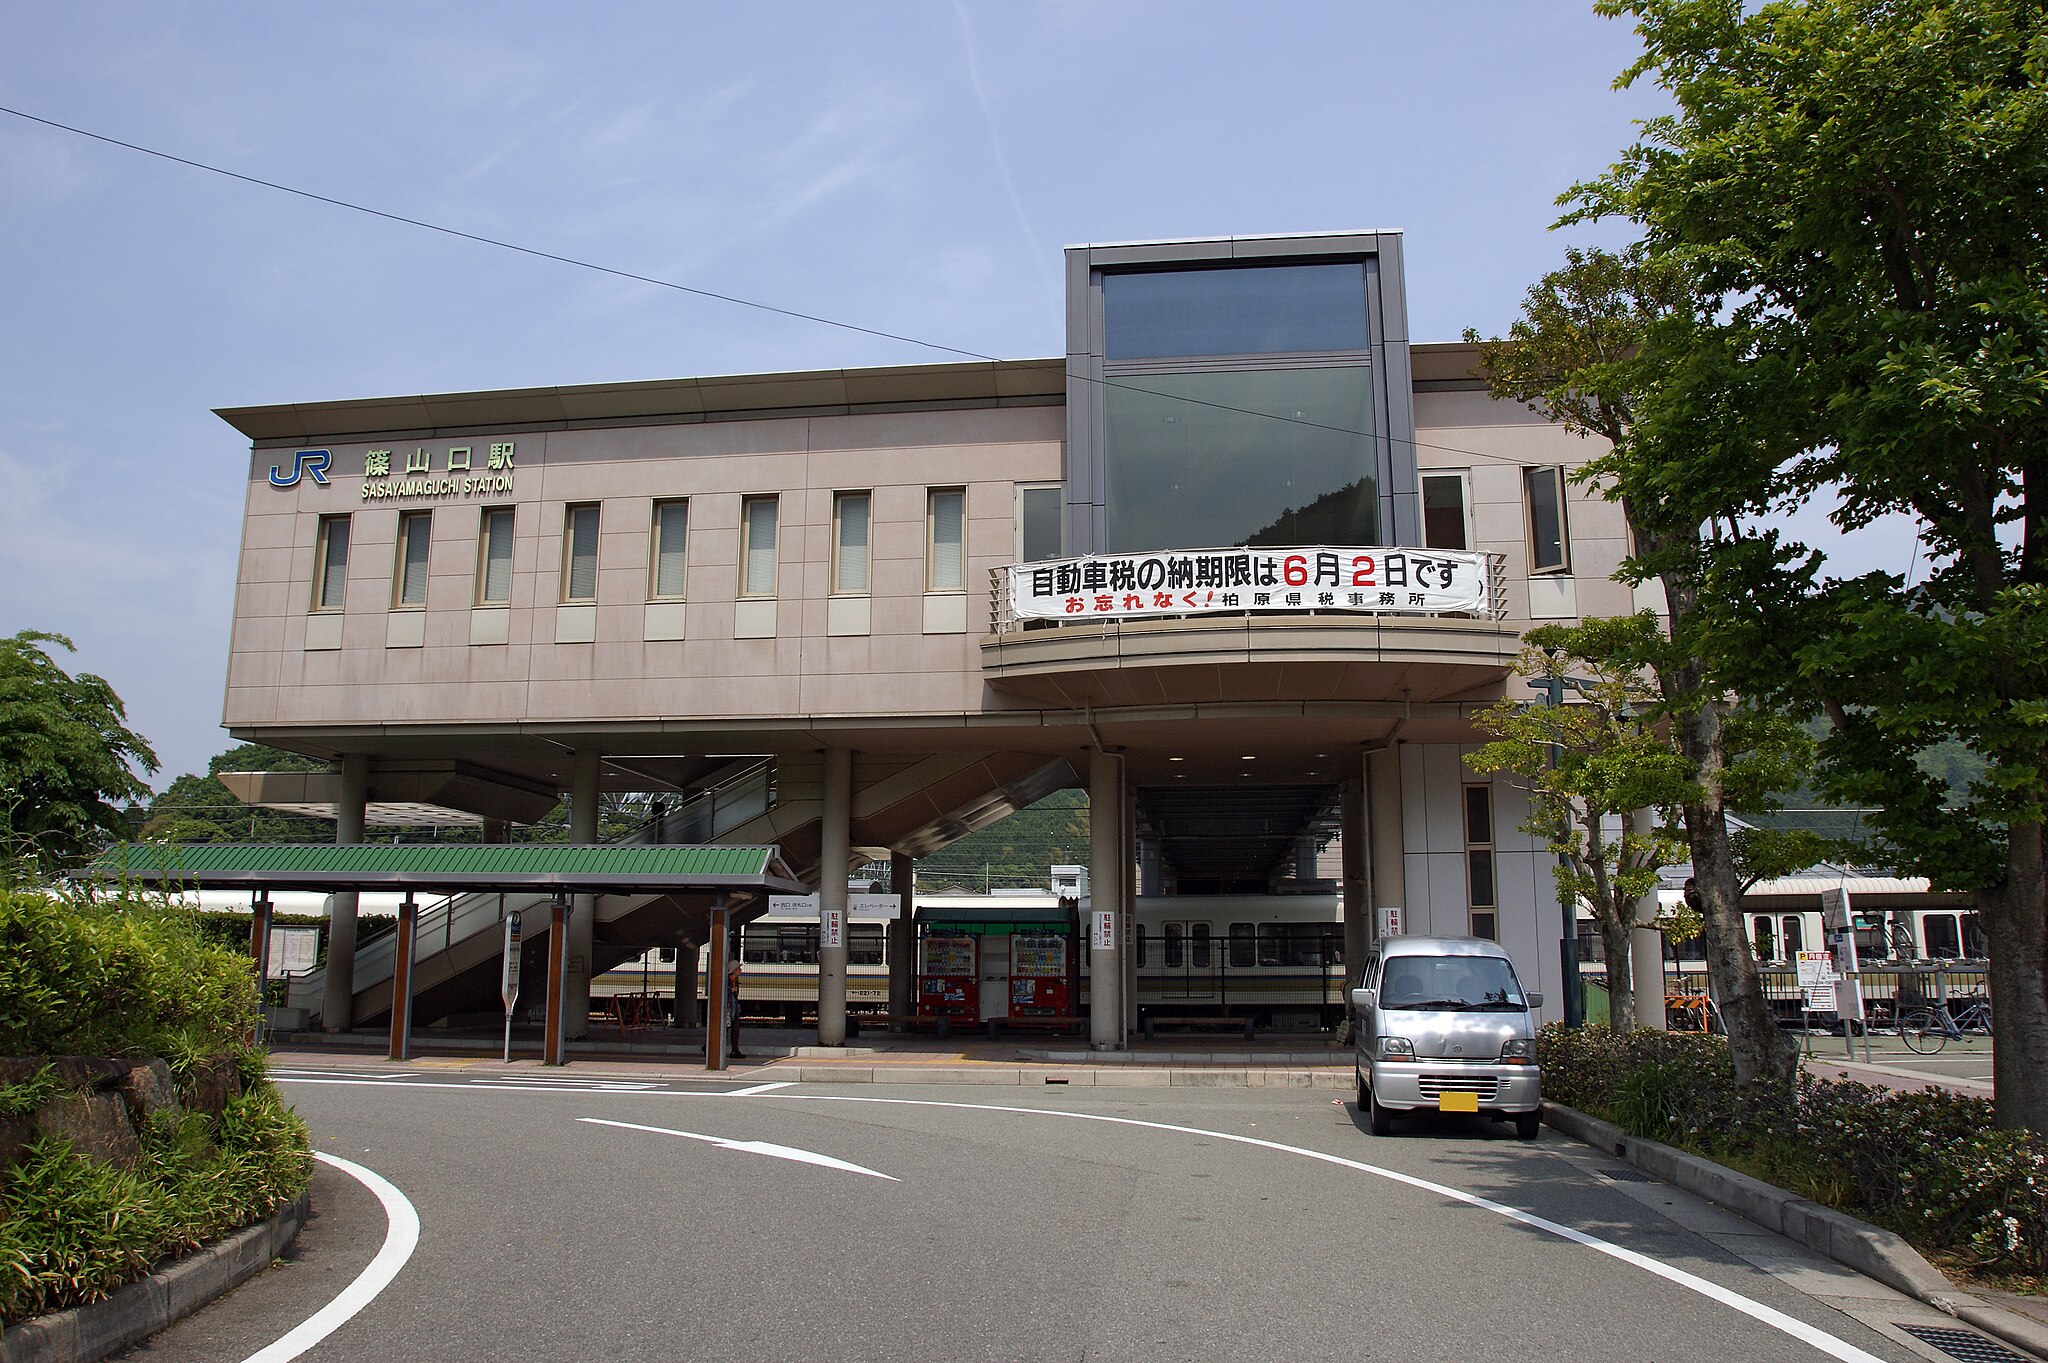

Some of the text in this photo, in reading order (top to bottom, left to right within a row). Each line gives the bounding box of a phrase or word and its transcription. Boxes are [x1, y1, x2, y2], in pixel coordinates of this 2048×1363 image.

[269, 448, 333, 487] JR
[364, 442, 516, 477] 篠山口駅
[361, 475, 514, 499] SASAYAMAGUCHI STATION
[1033, 553, 1458, 597] 自動車税の納期限は6月2日です
[1222, 592, 1426, 607] 柏原県税事務所
[1103, 914, 1111, 946] 駐輪禁止
